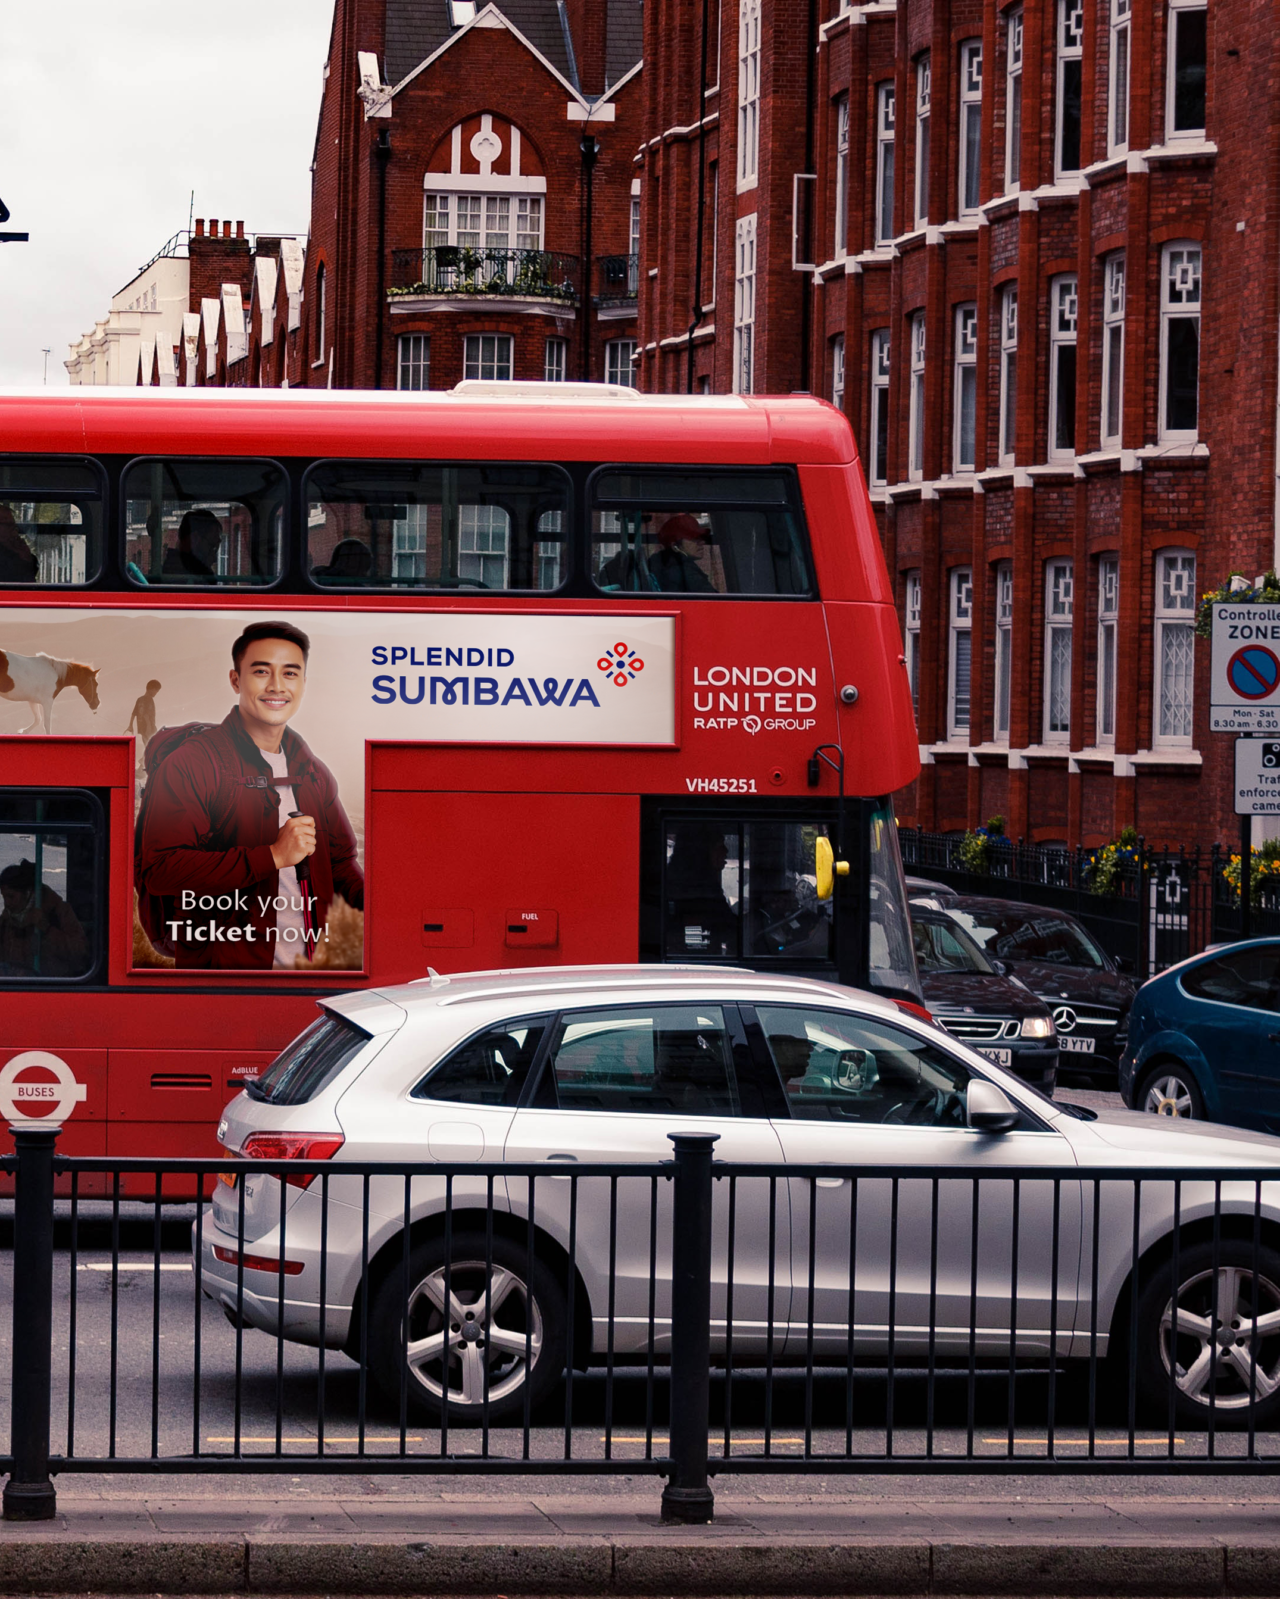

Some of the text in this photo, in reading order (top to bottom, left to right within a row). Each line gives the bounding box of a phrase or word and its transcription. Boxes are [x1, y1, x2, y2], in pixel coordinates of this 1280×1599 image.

[1218, 608, 1280, 621] Controlle
[1228, 625, 1280, 640] ZONE
[371, 645, 515, 668] SPLENDID
[693, 666, 817, 688] LONDON
[371, 674, 601, 708] SUMBAWA
[693, 692, 817, 712] UNITED
[1233, 709, 1252, 717] Mon
[1259, 709, 1275, 718] Sat
[694, 717, 817, 731] RATP GROUP
[1214, 720, 1235, 728] 8.30
[686, 778, 757, 793] VH45251
[181, 889, 318, 918] Book your
[165, 920, 330, 943] Ticket now!
[1071, 1039, 1093, 1051] YTV
[231, 1066, 259, 1074] AdBLUE
[18, 1087, 54, 1097] BUSES
